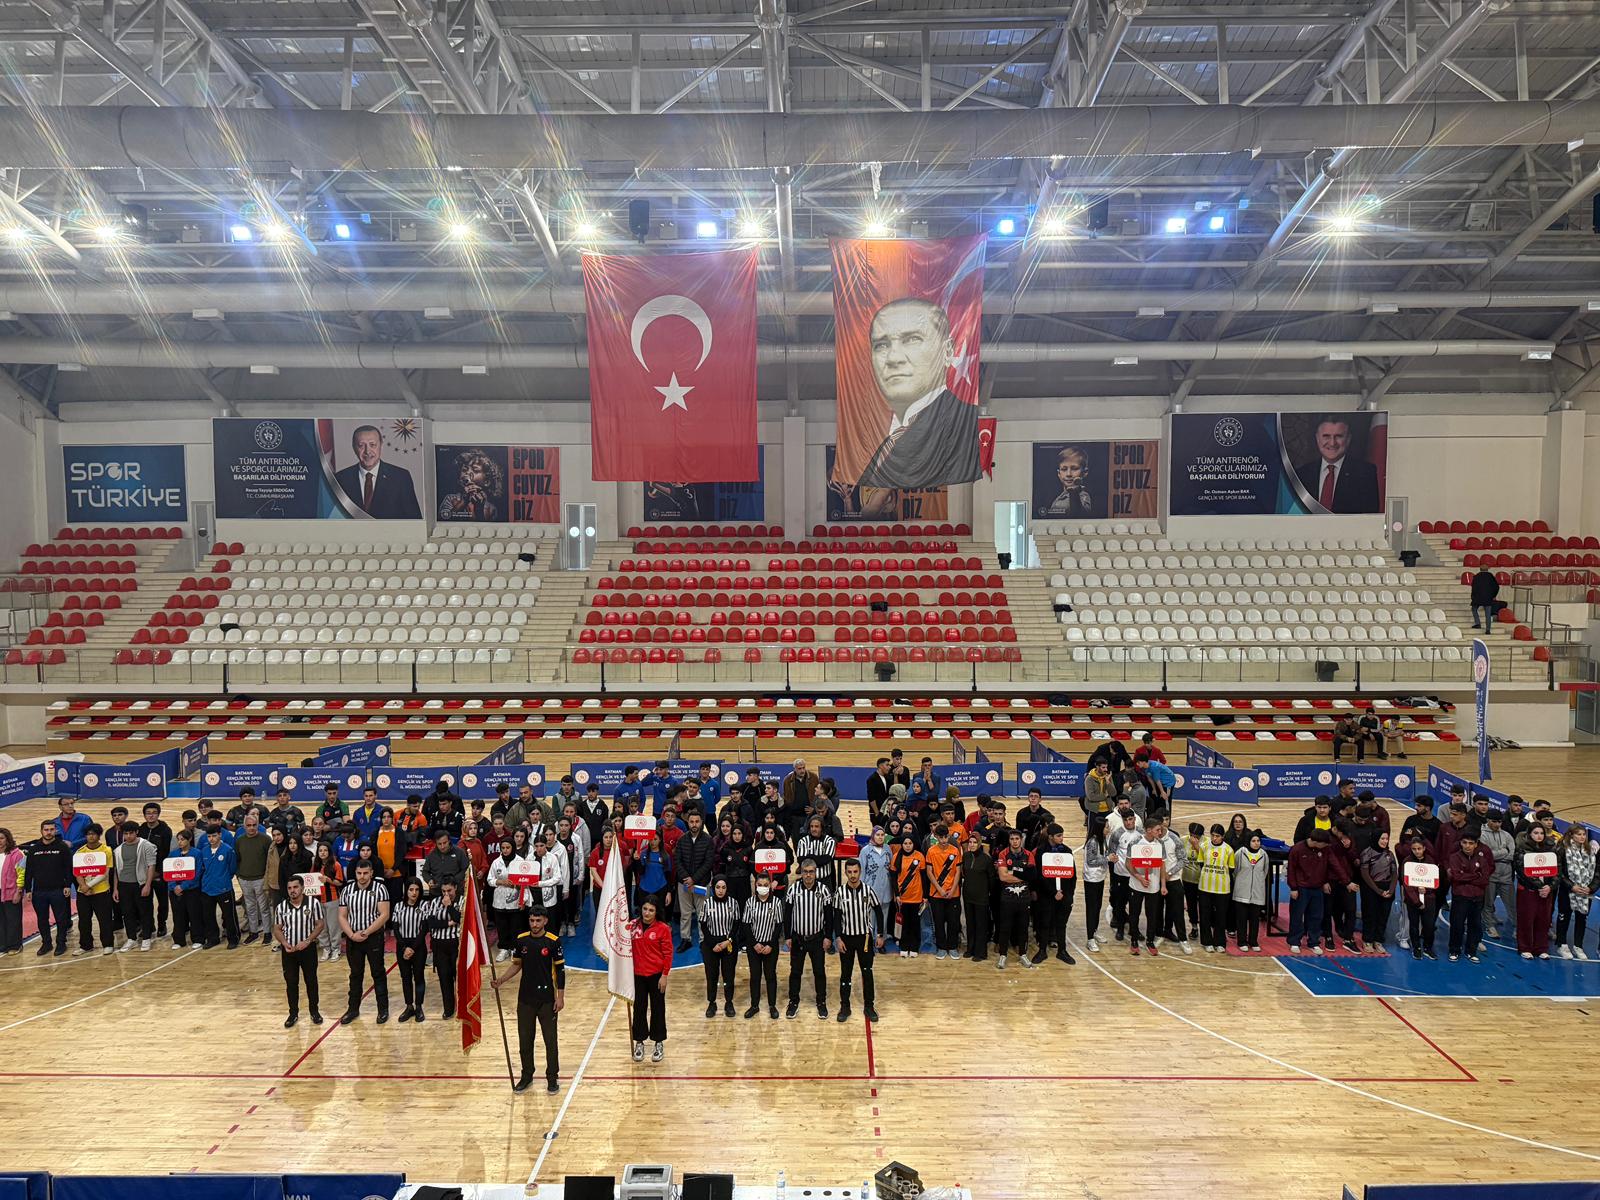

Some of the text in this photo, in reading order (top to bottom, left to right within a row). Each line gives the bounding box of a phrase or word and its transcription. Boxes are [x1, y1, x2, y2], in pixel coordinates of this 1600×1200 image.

[513, 449, 544, 470] SPOR
[1115, 445, 1144, 464] SPOR
[1196, 456, 1259, 464] TÜM ANTRENÖR
[71, 462, 141, 480] SPOR
[72, 485, 180, 507] TÜRKİYE
[1114, 492, 1132, 514] BİZ
[514, 498, 533, 520] BİZ
